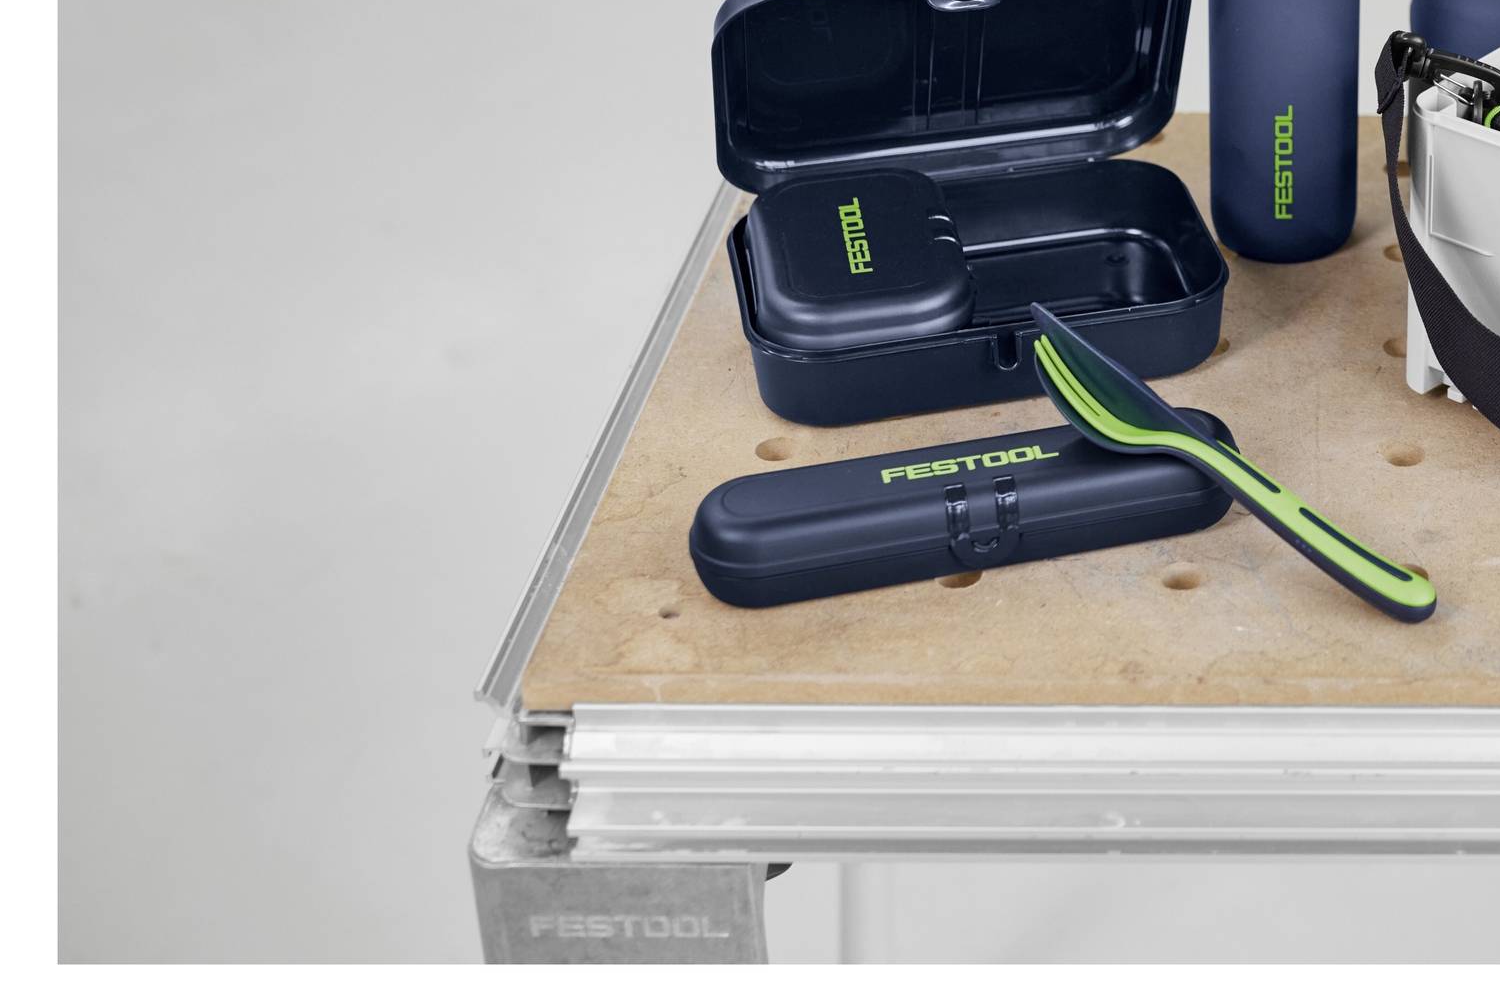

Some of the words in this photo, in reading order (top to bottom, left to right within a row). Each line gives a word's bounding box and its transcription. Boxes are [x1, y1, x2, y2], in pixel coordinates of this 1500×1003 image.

[1274, 104, 1294, 220] FESTOOL
[839, 197, 874, 275] FESTOOL
[881, 444, 1060, 484] FESTOOL
[529, 914, 729, 938] FESTOOL
